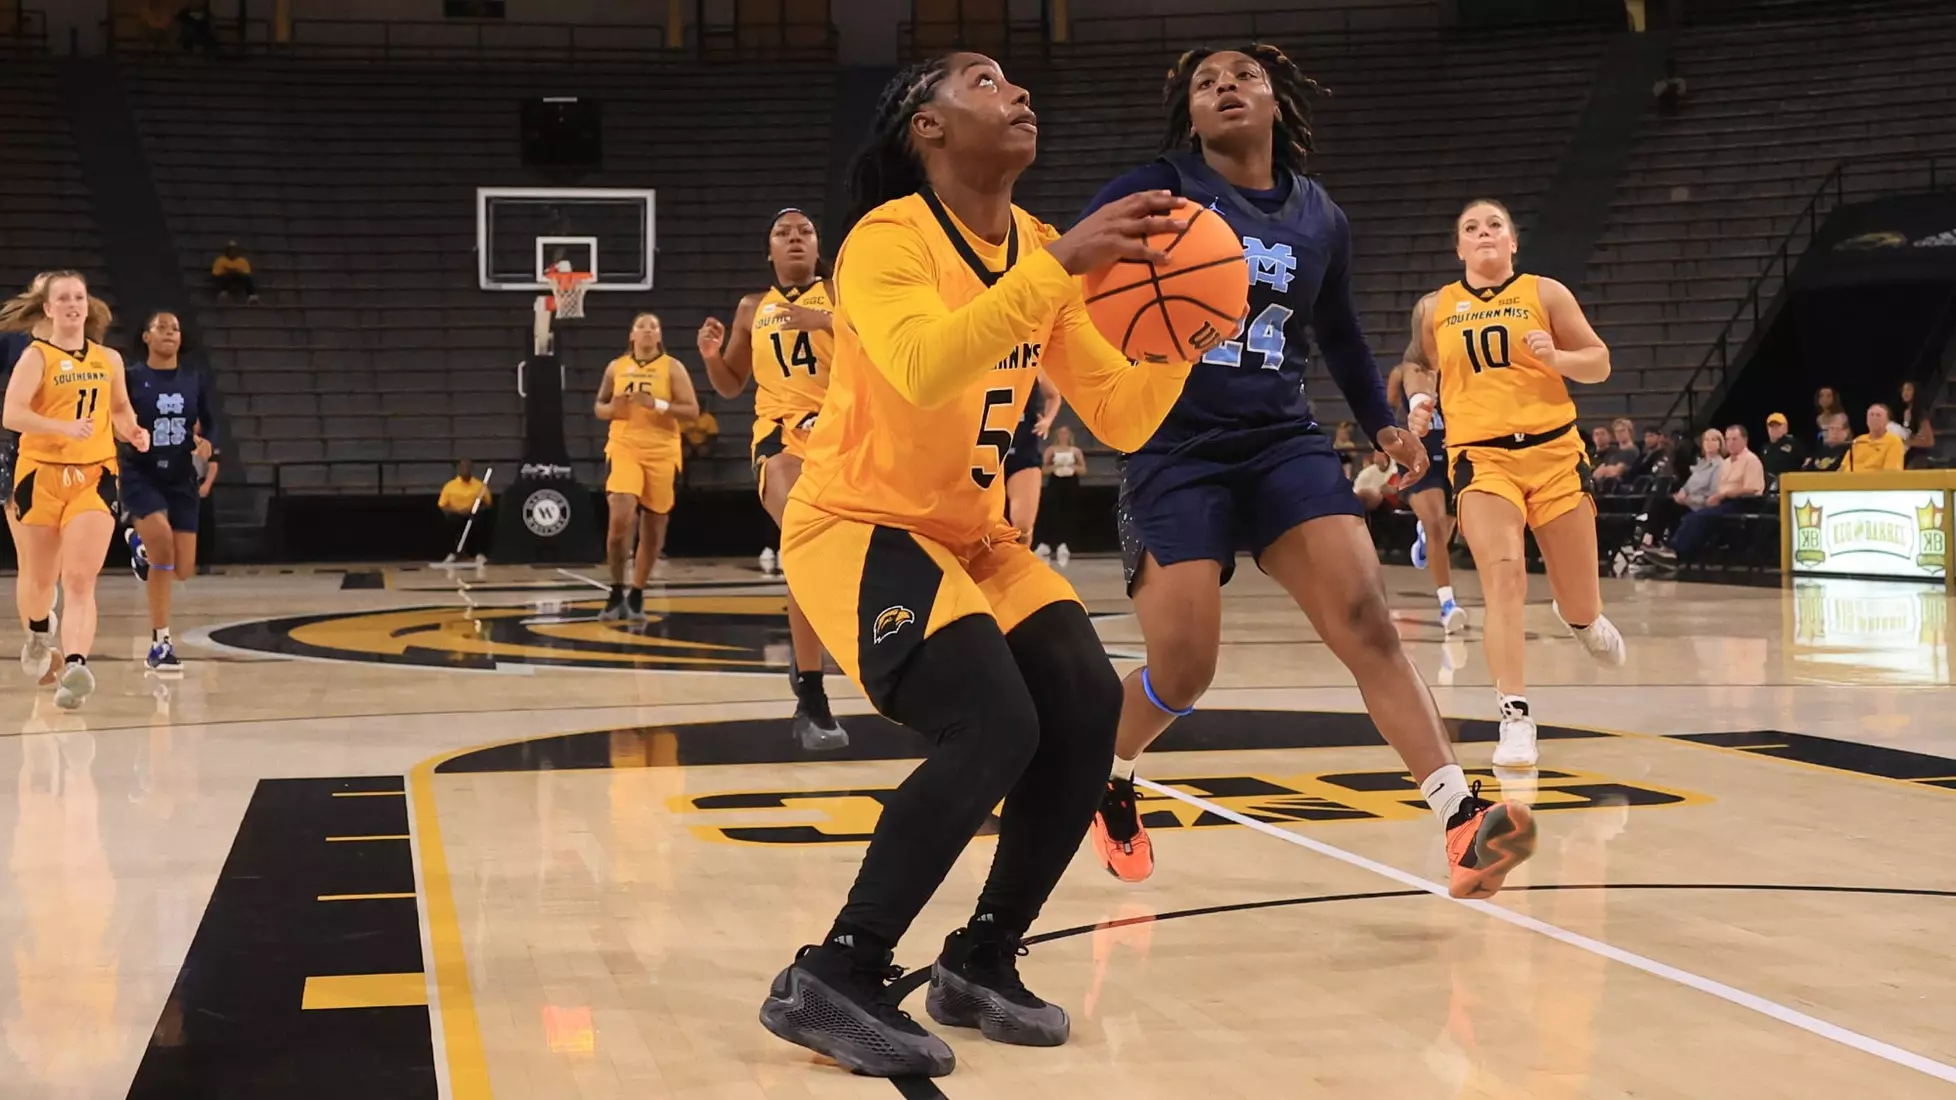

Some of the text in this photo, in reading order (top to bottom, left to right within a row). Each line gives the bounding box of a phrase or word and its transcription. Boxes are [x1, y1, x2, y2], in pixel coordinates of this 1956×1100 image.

[1446, 306, 1530, 328] SOUTHERN MISS
[769, 331, 818, 378] 14
[1461, 324, 1512, 375] 10
[53, 372, 99, 386] SOUTHERN
[76, 388, 98, 419] 11
[153, 417, 186, 446] 25
[969, 386, 1015, 491] 5
